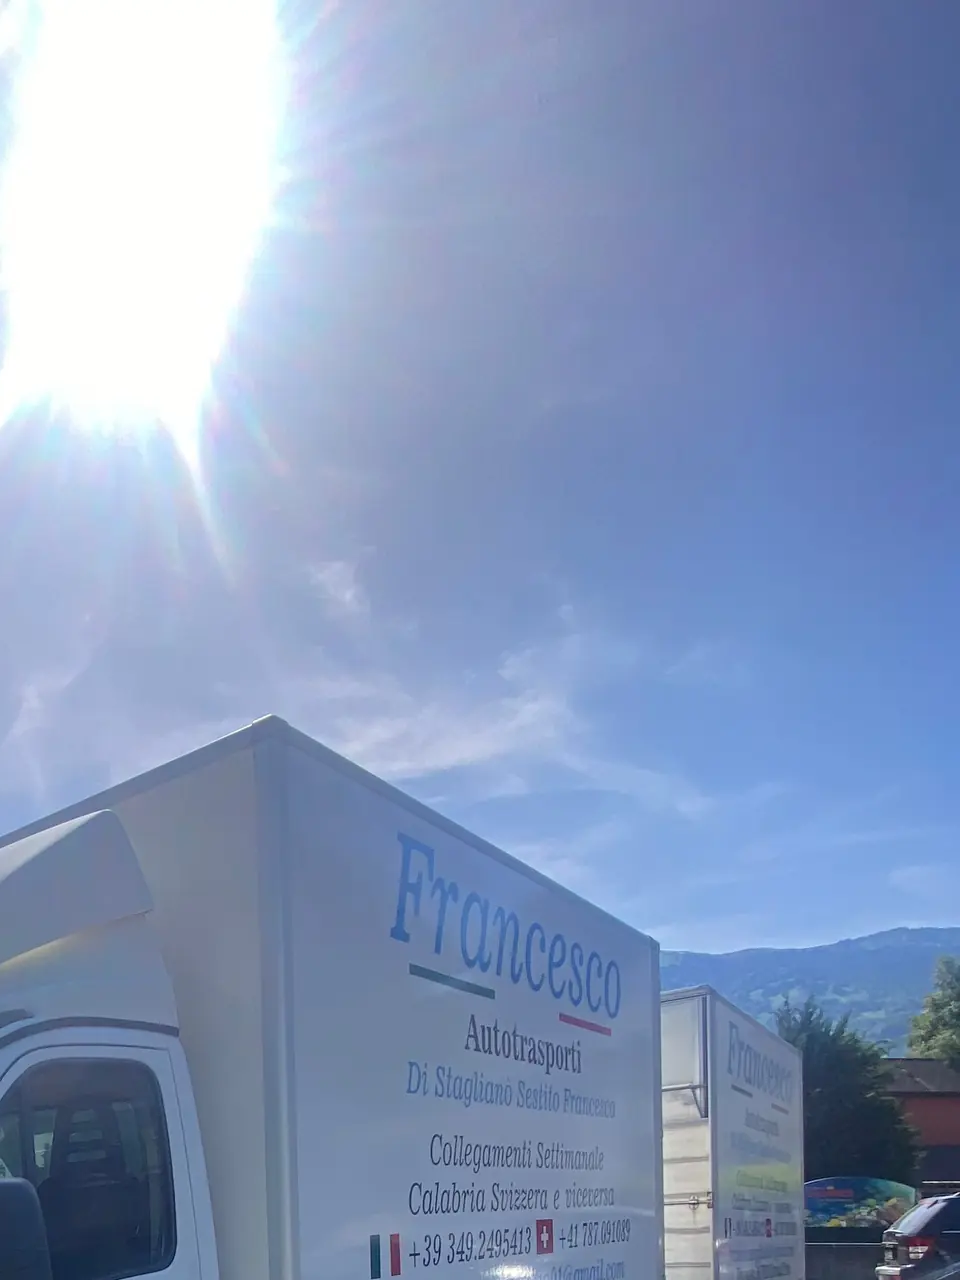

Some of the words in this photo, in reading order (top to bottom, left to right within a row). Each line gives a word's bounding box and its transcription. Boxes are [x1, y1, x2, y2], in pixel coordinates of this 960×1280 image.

[390, 830, 621, 1019] Francesco
[464, 1013, 582, 1075] Autotrasporti
[406, 1061, 429, 1095] Di
[516, 1080, 560, 1112] Sestito
[429, 1133, 533, 1174] Collegamenti
[408, 1182, 486, 1216] Calabria
[490, 1182, 548, 1213] Svizzera
[553, 1188, 561, 1211] e
[409, 1234, 442, 1268] +39
